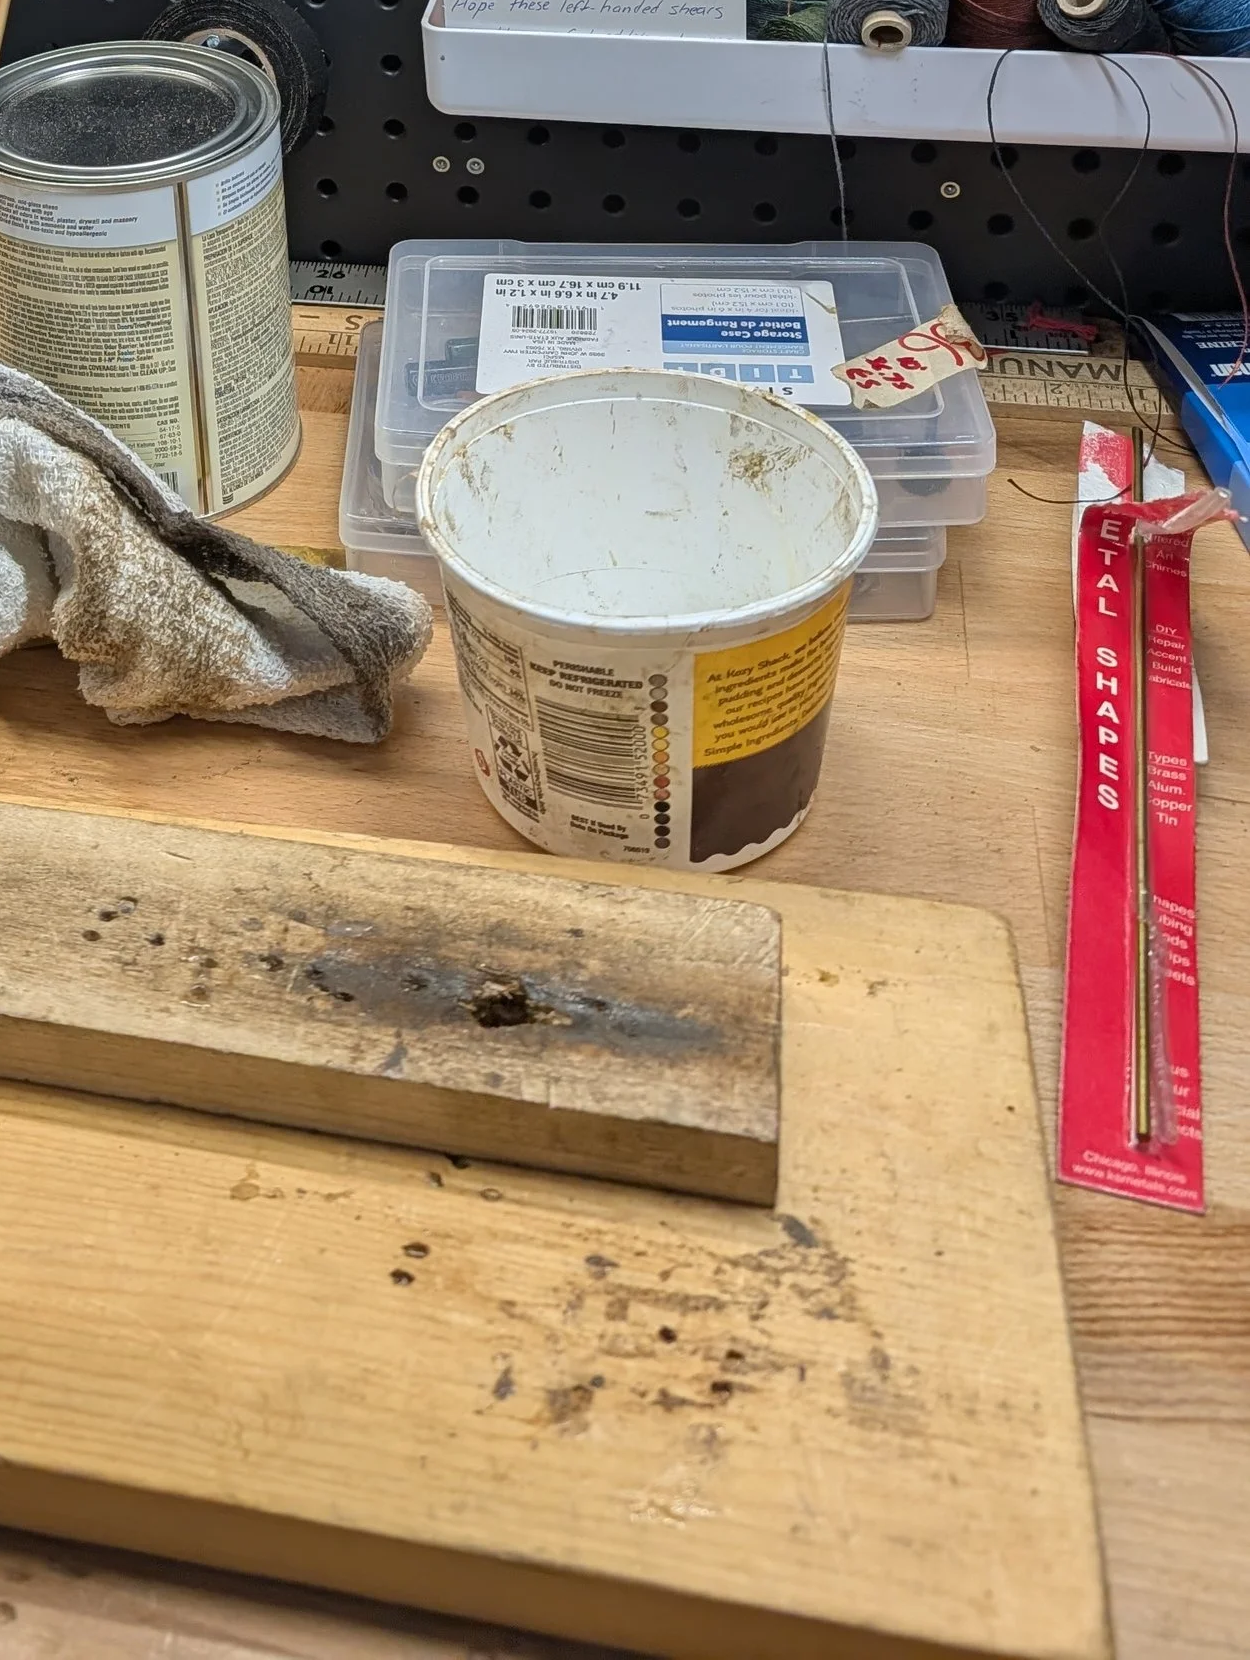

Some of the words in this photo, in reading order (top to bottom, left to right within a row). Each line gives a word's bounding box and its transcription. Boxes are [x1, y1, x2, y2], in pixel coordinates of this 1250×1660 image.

[668, 1, 724, 21] shears
[316, 269, 346, 279] 26
[518, 279, 524, 287] 3
[560, 281, 582, 289] 16.7
[618, 282, 641, 291] 11.9
[496, 288, 506, 297] in
[510, 289, 526, 297] 1.2
[540, 289, 550, 298] in
[555, 290, 572, 299] 6.6
[587, 291, 597, 299] in
[601, 291, 618, 300] 4.7
[667, 319, 737, 328] Rangement
[759, 321, 800, 329] Boîtier
[329, 334, 354, 346] 11
[721, 330, 750, 338] Case
[1051, 383, 1063, 395] 2
[1096, 509, 1124, 618] ETAL
[1155, 624, 1178, 635] DIY
[552, 660, 615, 676] PERISHABLE
[727, 666, 754, 680] Kozy
[1152, 661, 1182, 675] Build
[559, 672, 643, 689] REFRIGERATED
[715, 670, 777, 693] ingredients
[549, 679, 563, 689] DO
[565, 682, 584, 692] NOT
[587, 686, 623, 698] FREEZE
[718, 686, 763, 707] pudding
[767, 676, 785, 690] and
[726, 705, 745, 714] our
[748, 691, 783, 709] recipes
[714, 731, 734, 743] you
[739, 719, 768, 734] would
[1096, 647, 1121, 810] SHAPES
[704, 743, 742, 756] Simple
[1148, 751, 1187, 766] Types
[1147, 765, 1187, 780] Brass
[1149, 780, 1186, 796] Alum.
[1156, 812, 1178, 826] Tin
[1153, 894, 1195, 919] hapes
